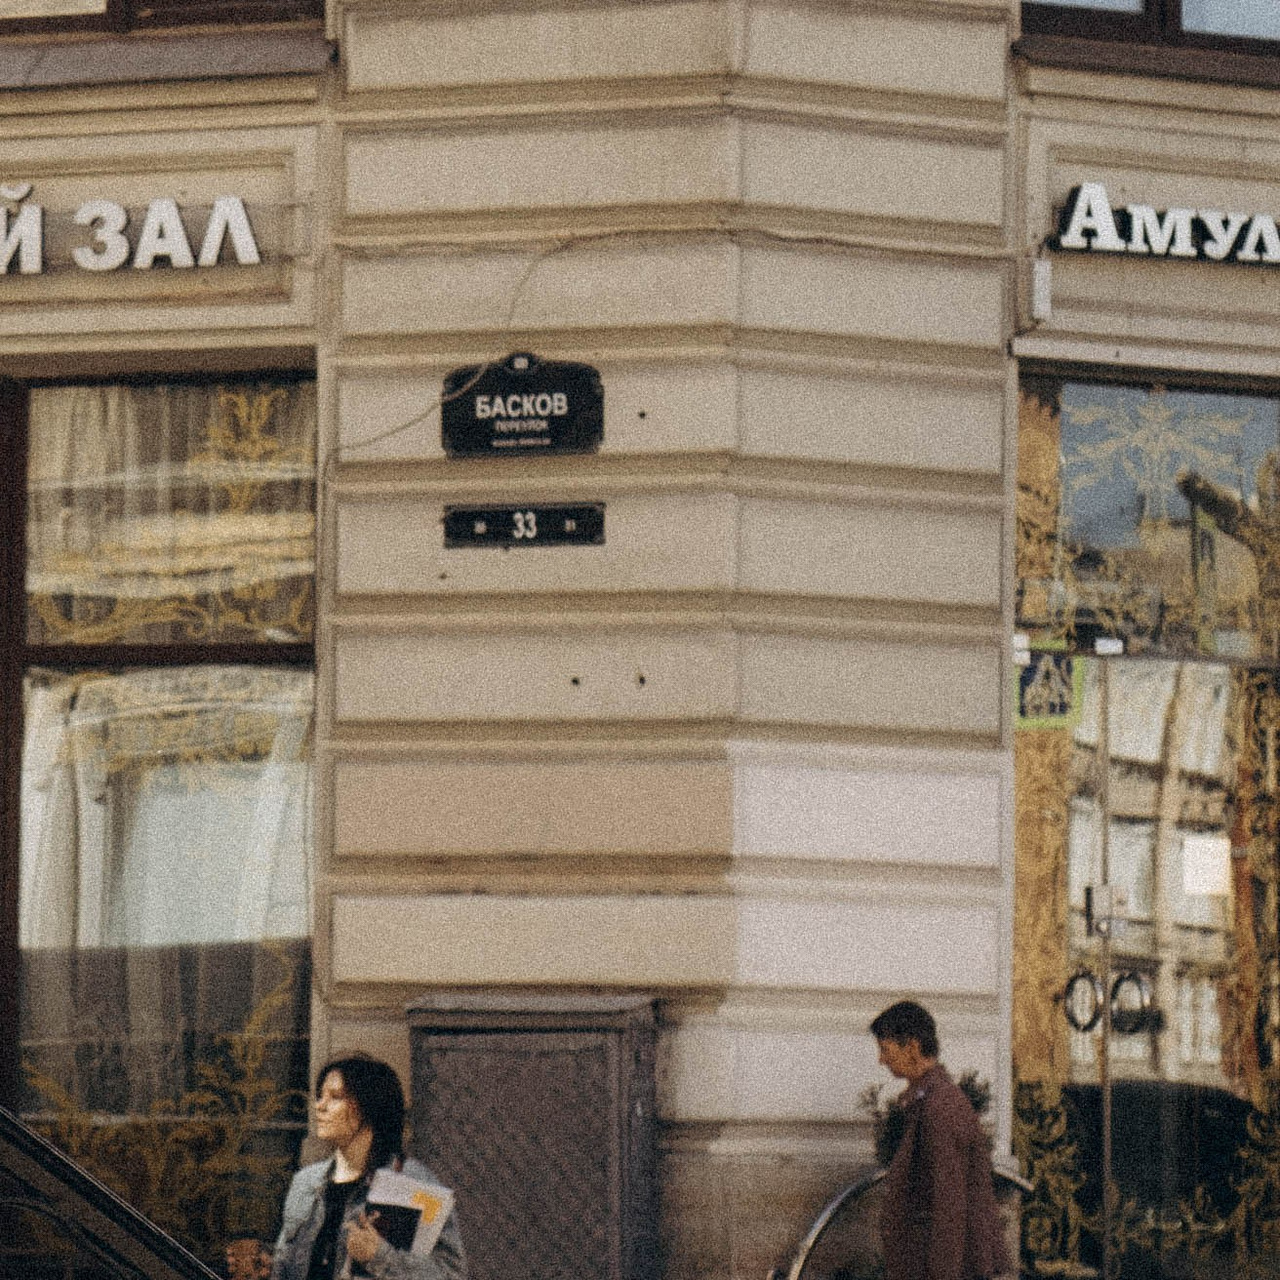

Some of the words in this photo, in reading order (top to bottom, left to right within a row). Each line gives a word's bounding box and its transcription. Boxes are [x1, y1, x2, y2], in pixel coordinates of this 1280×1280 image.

[72, 196, 261, 271] ЗАЛ
[475, 392, 568, 419] БАСКОВ
[512, 512, 537, 539] 33
